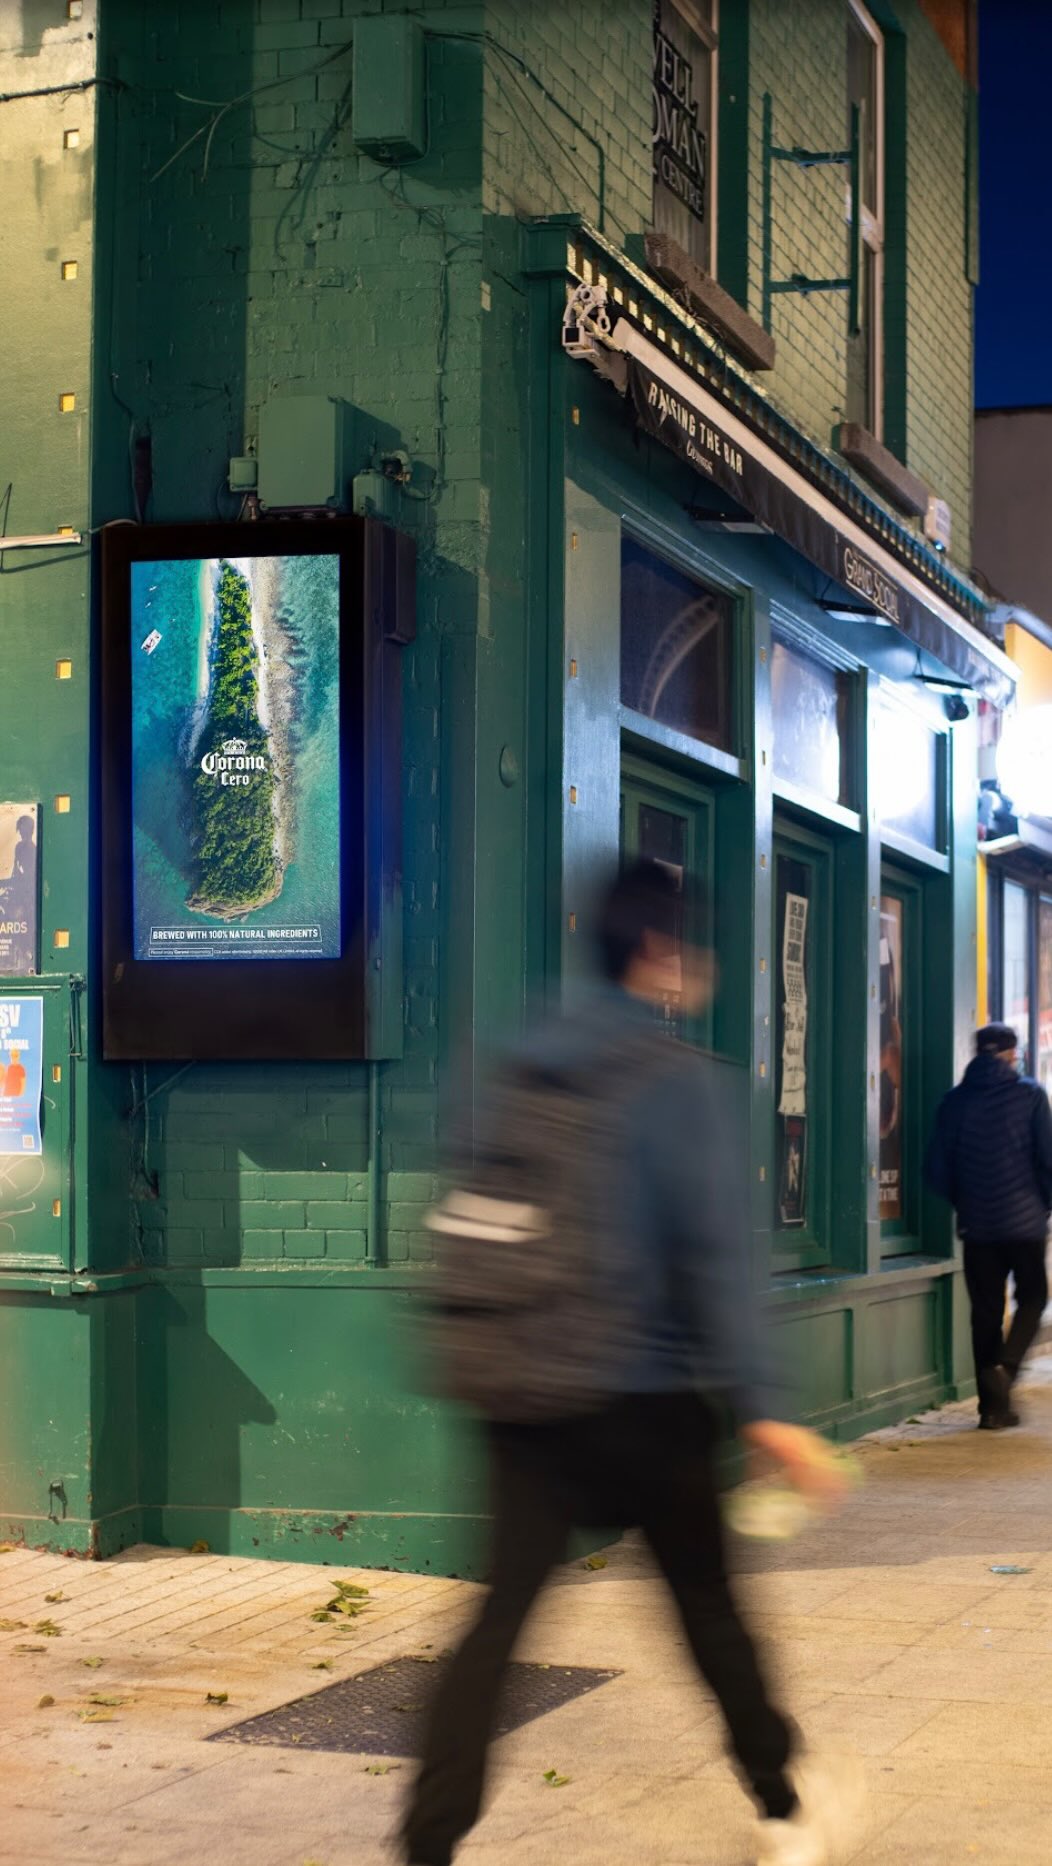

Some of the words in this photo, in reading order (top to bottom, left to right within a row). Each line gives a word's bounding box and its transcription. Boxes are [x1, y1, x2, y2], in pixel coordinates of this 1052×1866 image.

[661, 155, 704, 216] CENTRE
[648, 382, 695, 437] RAISING
[700, 422, 721, 456] THE
[723, 442, 743, 476] BAR
[201, 752, 266, 776] Corona
[221, 771, 250, 786] Cero
[153, 931, 185, 940] BREWED
[187, 930, 207, 939] WITH
[209, 930, 228, 939] 100%
[229, 929, 265, 939] NATURAL
[267, 928, 318, 938] INGREDIENTS
